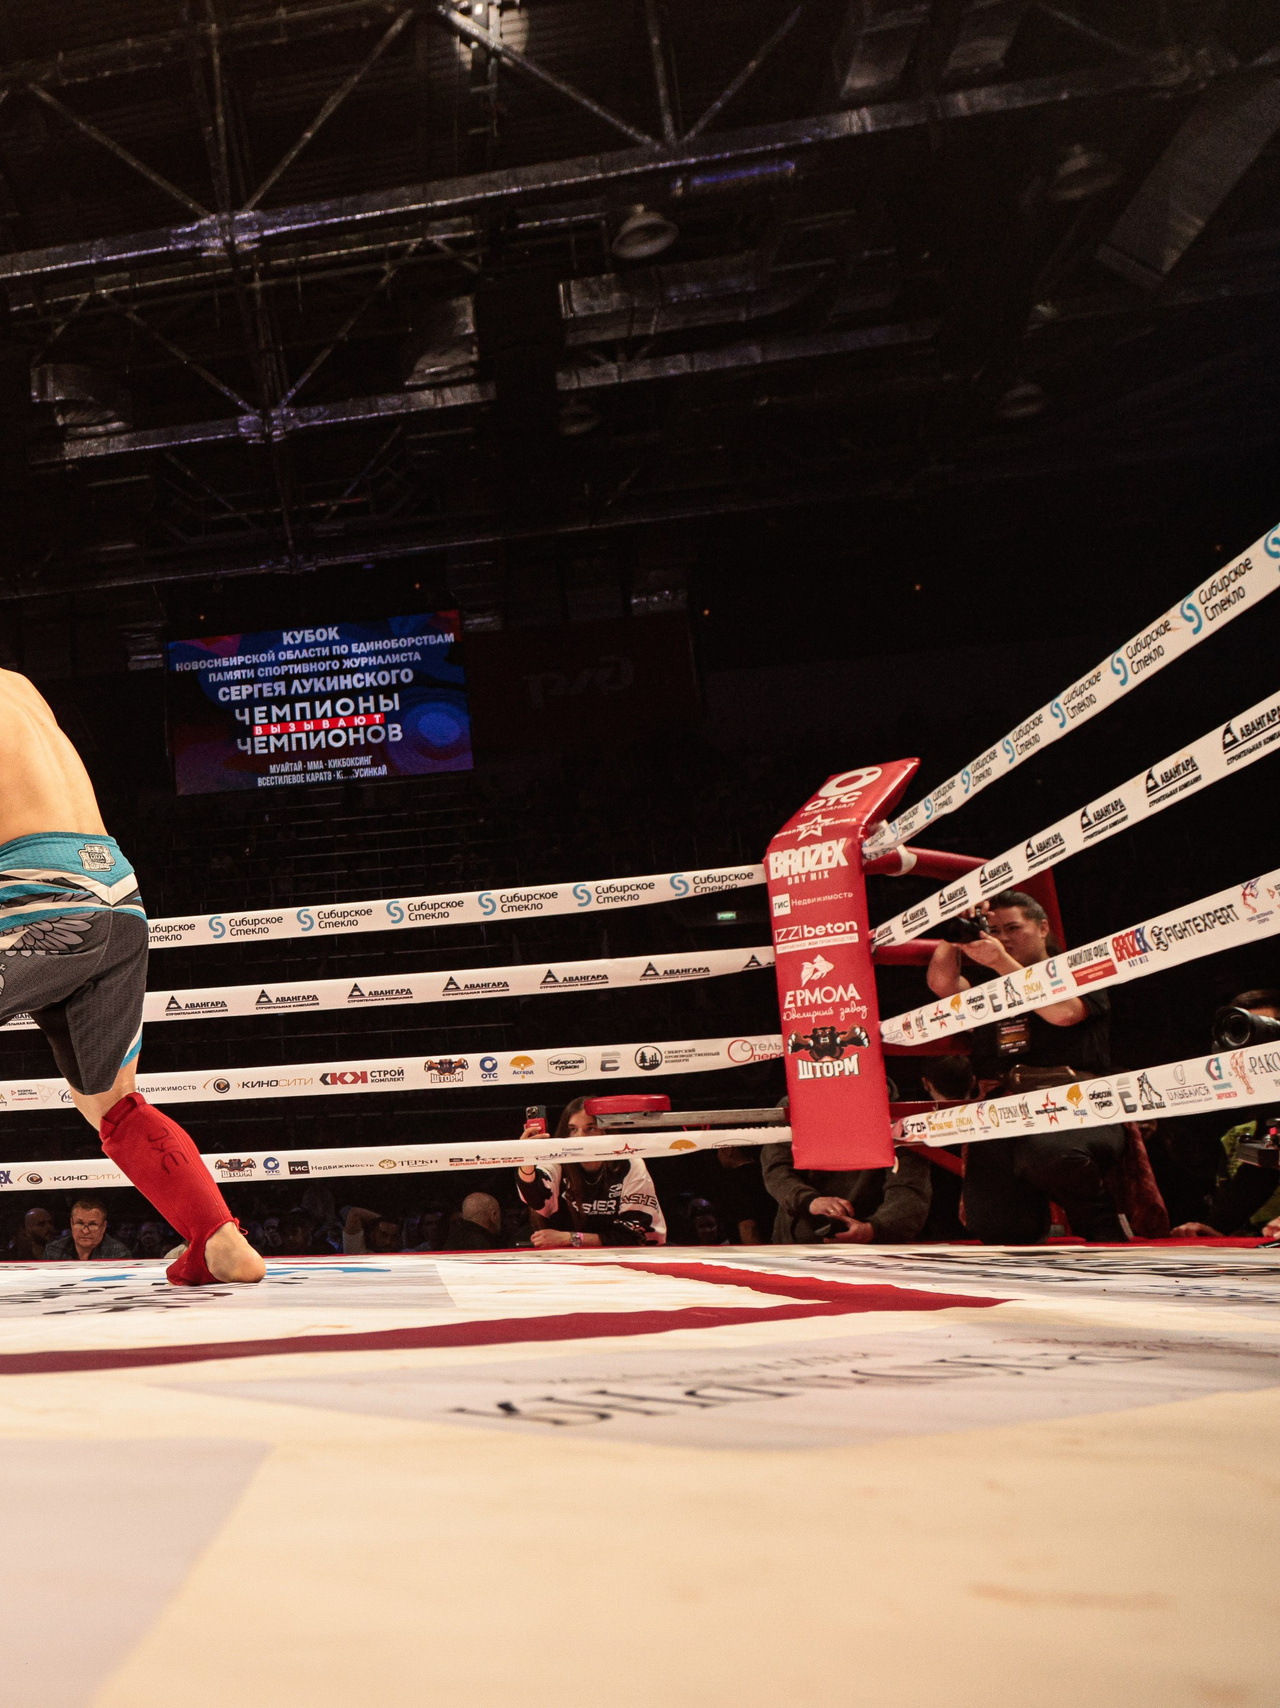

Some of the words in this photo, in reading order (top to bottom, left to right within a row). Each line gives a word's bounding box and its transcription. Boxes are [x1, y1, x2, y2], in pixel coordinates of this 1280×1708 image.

[1199, 558, 1253, 605] Сибирское
[1204, 586, 1246, 621] Стекло
[282, 626, 340, 645] КУБОК
[1126, 620, 1171, 659] Сибирское
[175, 650, 275, 672] НОВОСИБИРСКОЙ
[279, 647, 330, 661] ОБЛАСТИ
[332, 645, 349, 655] ПО
[351, 632, 455, 654] ЕДИНОБОРСТВАМ
[208, 669, 255, 682] ПАМЯТИ
[257, 660, 339, 678] СПОРТИВНОГО
[342, 651, 421, 668] ЖУРНАЛИСТА
[1131, 645, 1165, 675] Стекло
[218, 680, 286, 701] СЕРГЕЯ
[290, 668, 414, 695] ЛУКИНСКОГО
[235, 693, 400, 725] ЧЕМПИОНЫ
[255, 714, 382, 734] ВЫЗЫВАЮТ
[237, 723, 403, 755] ЧЕМПИОНОВ
[692, 871, 754, 886] Сибирское
[595, 881, 655, 896] Сибирское
[499, 890, 558, 905] Сибирское
[596, 892, 640, 904] Стекло
[317, 907, 373, 920] Сибирское
[407, 899, 464, 914] Сибирское
[500, 902, 543, 913] Стекло
[229, 914, 283, 927] Сибирское
[318, 918, 359, 929] Стекло
[408, 910, 450, 922] Стекло
[149, 923, 196, 934] ибирское
[229, 925, 270, 936] Стекло
[1165, 904, 1240, 944] FIGHTEXPERT
[148, 933, 182, 942] текло
[464, 981, 509, 990] АВАНГАРД
[562, 974, 609, 983] АВАНГАРД
[275, 994, 319, 1003] АВАНГАРД
[368, 988, 412, 997] АВАНГАРД
[784, 983, 861, 1009] ЕРМОЛА
[185, 1000, 228, 1009] АВАНГАРД
[370, 1067, 405, 1079] СТРОЙ
[798, 1053, 859, 1079] ШТОРМ
[430, 1072, 464, 1084] ШТОРМ
